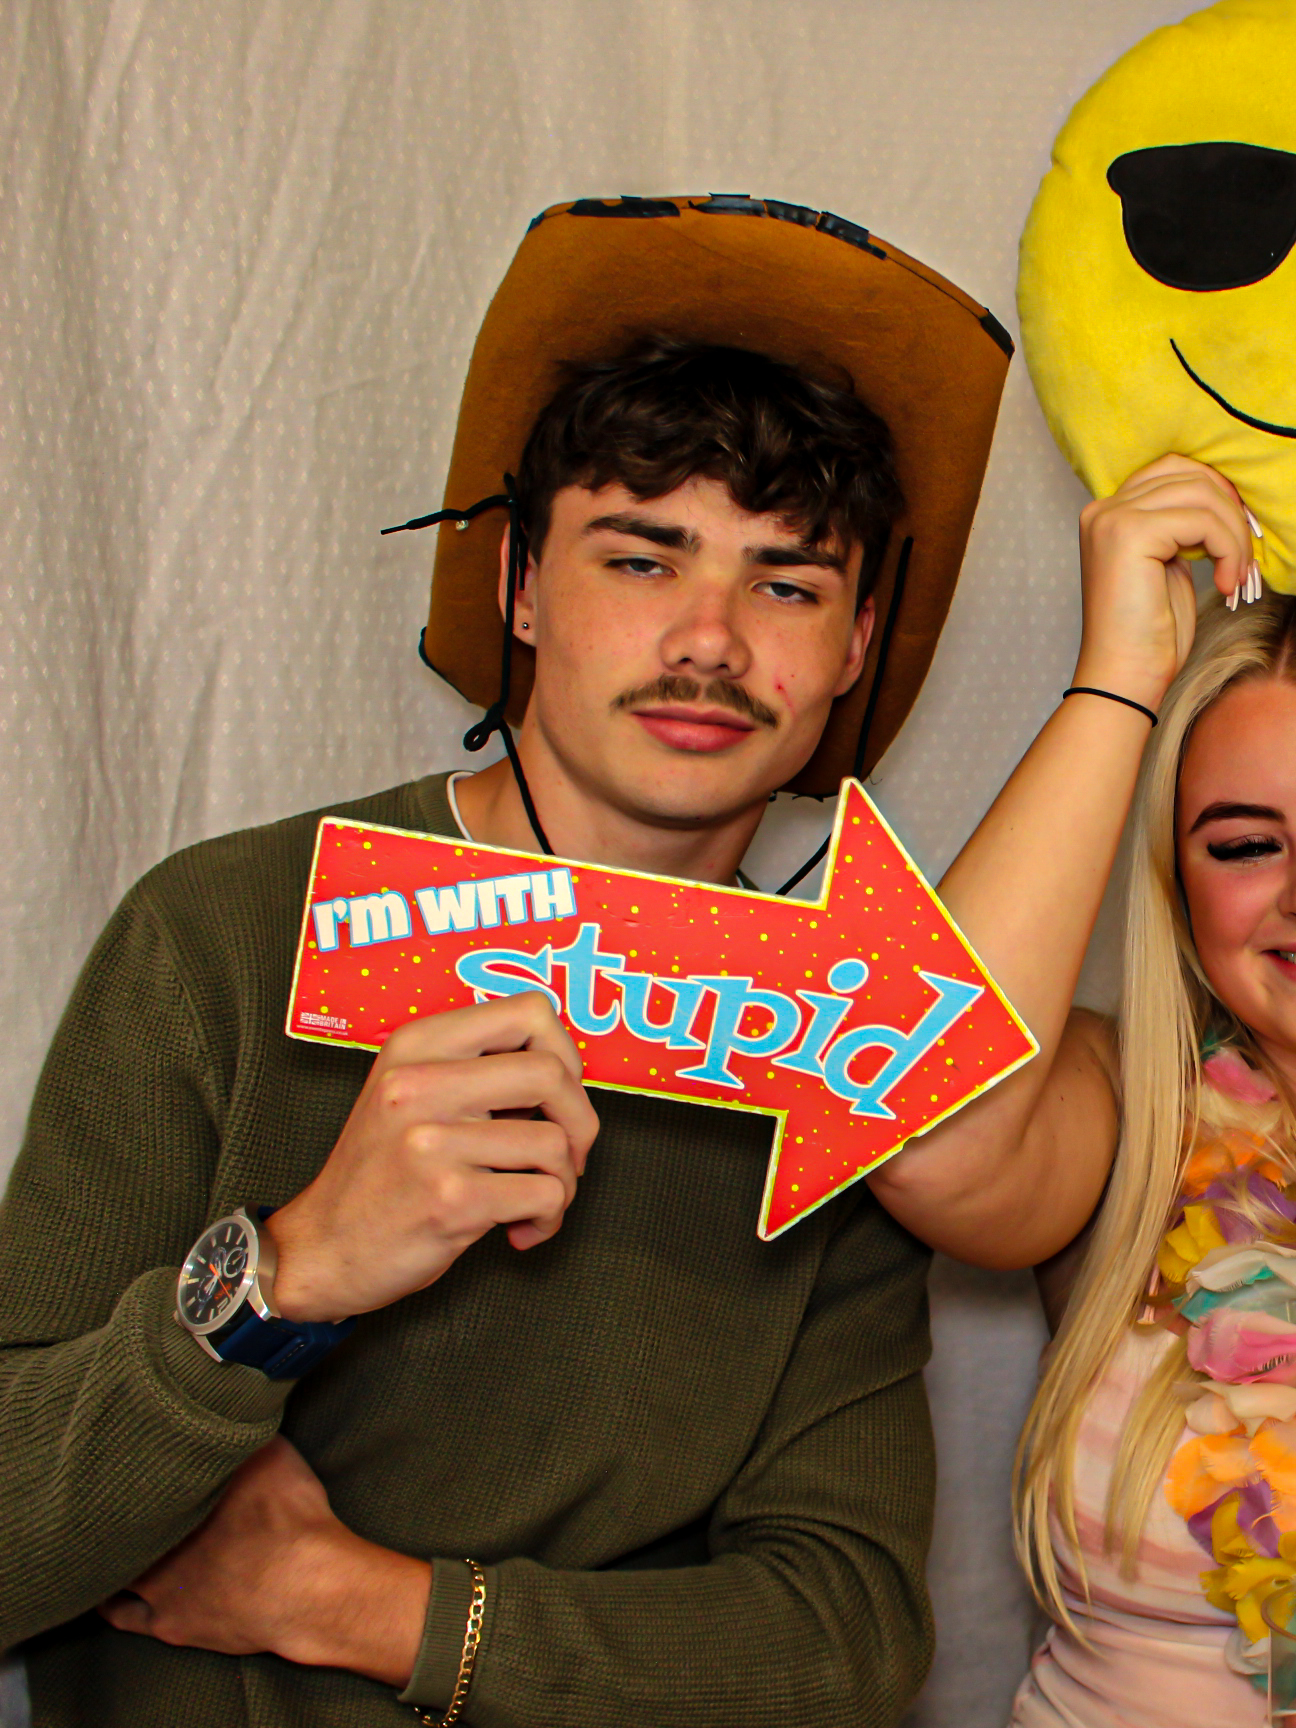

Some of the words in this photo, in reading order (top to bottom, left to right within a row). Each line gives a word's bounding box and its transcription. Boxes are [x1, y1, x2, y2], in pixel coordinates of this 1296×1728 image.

[414, 867, 577, 936] WITH
[320, 1014, 339, 1023] MADE
[320, 1021, 347, 1030] BRITAIN
[455, 922, 986, 1120] stupid
